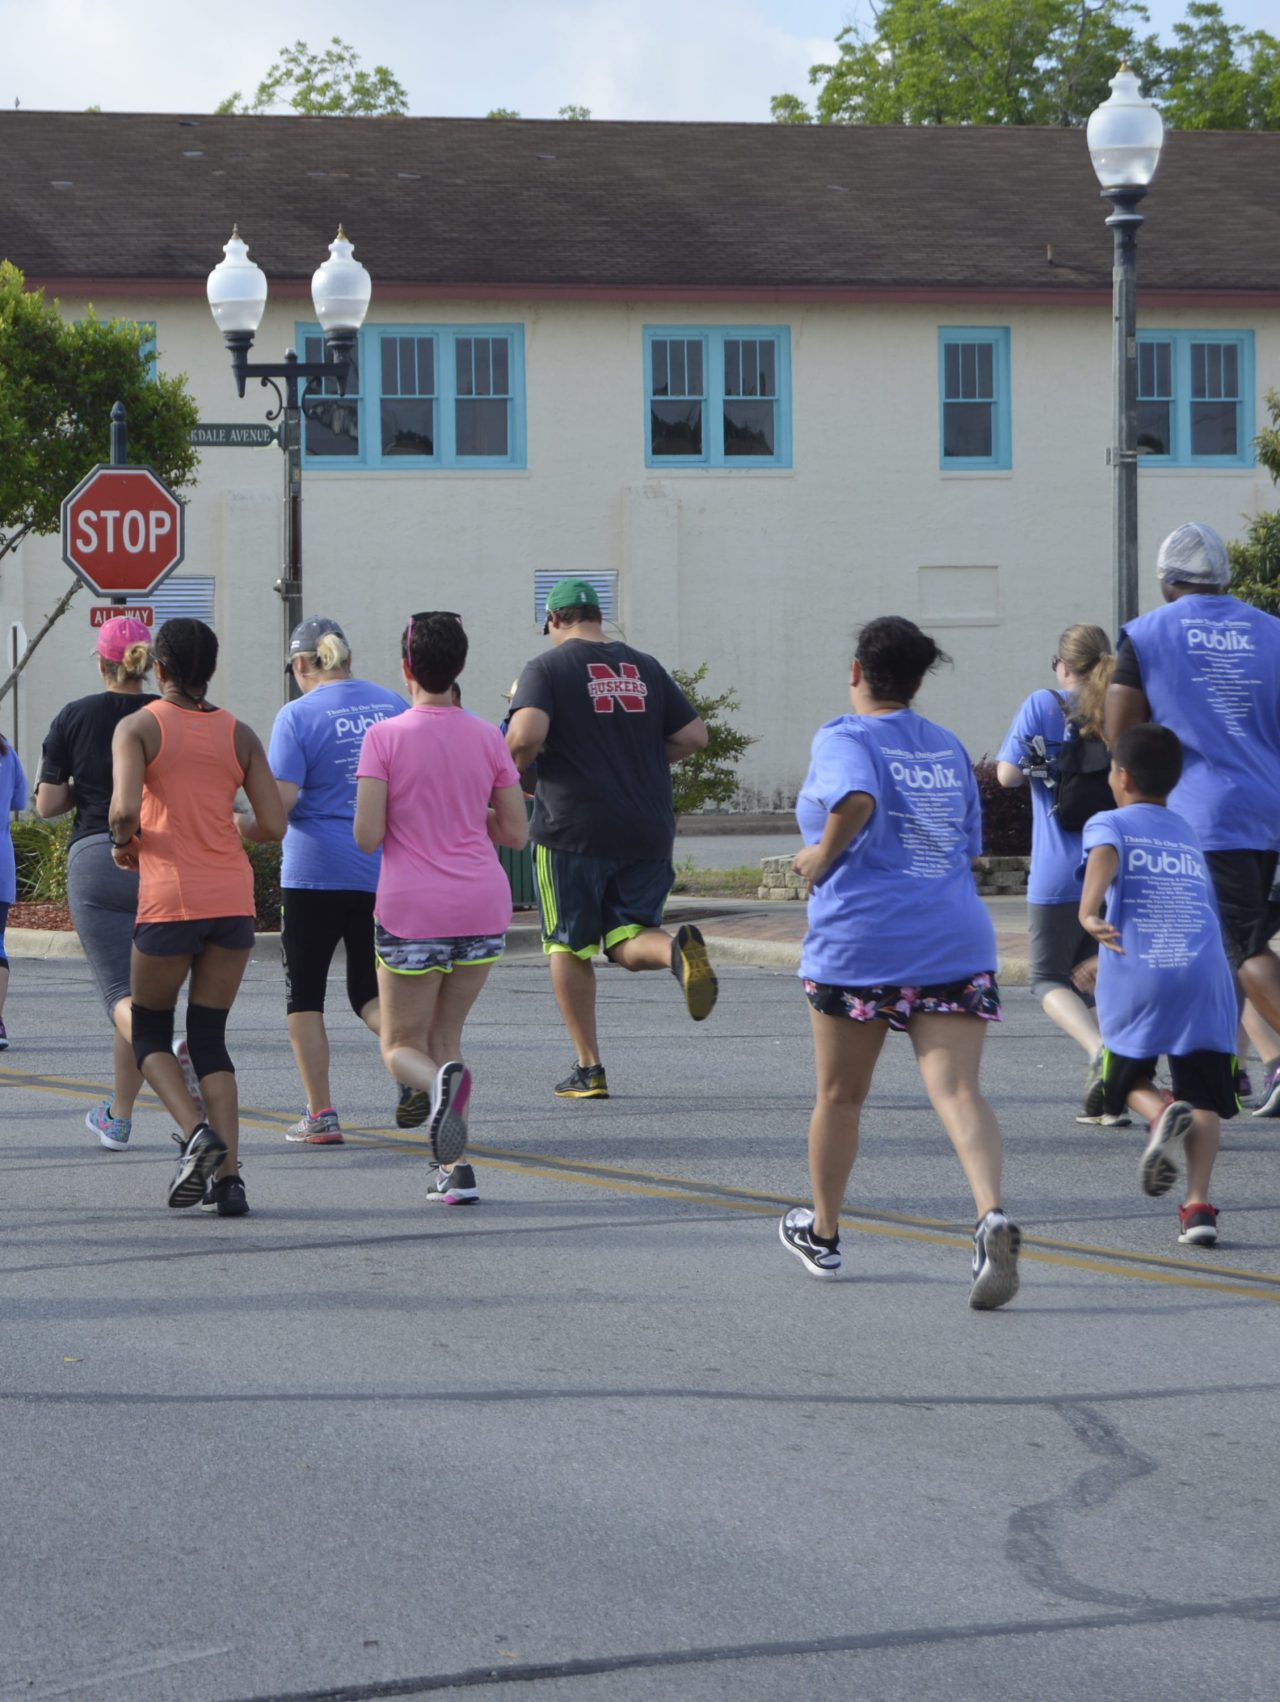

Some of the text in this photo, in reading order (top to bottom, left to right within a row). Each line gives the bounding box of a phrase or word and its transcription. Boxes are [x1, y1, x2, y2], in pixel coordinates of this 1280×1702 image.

[187, 429, 271, 442] KDALE AVENUE
[75, 509, 171, 553] STOP
[1187, 629, 1252, 651] Publix
[590, 680, 646, 695] HUSKERS
[335, 712, 389, 737] Publi
[1128, 848, 1205, 879] Publix
